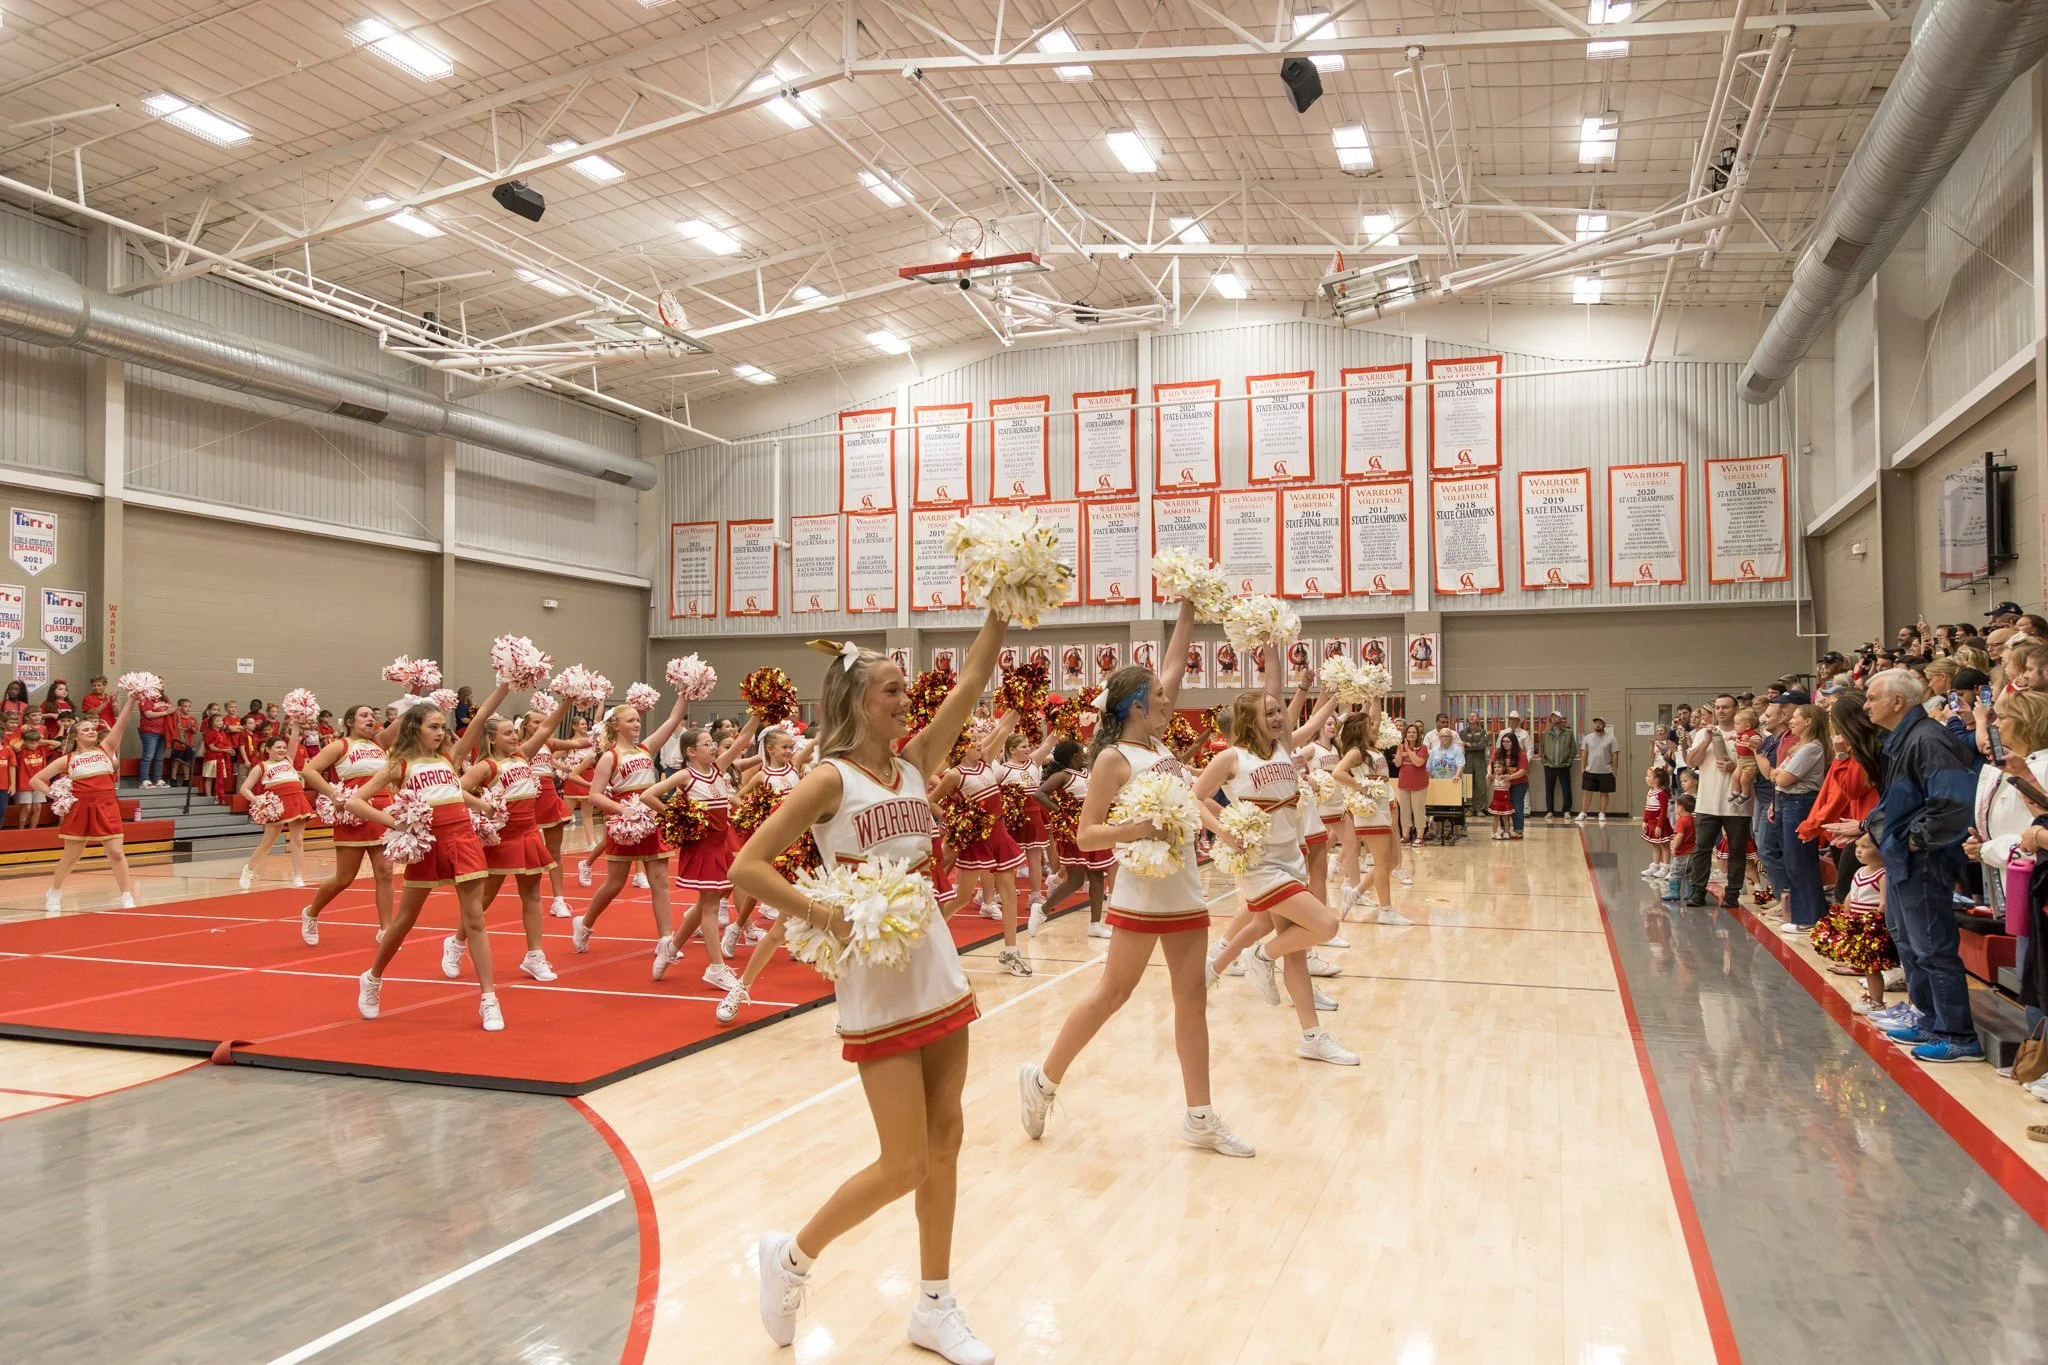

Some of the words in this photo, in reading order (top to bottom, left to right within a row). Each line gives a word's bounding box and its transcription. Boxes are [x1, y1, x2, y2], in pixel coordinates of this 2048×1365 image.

[1357, 373, 1395, 381] WARRIOR
[1274, 379, 1306, 388] WARRIOR
[1437, 390, 1455, 398] STATE
[1456, 388, 1494, 396] CHAMPIONS
[1088, 397, 1122, 405] WARRIOR
[1350, 396, 1367, 404] STATE
[1367, 394, 1403, 403] CHAMPIONS
[1256, 404, 1272, 412] STATE
[1273, 403, 1289, 411] FINAL
[1163, 413, 1179, 421] STATE
[1179, 411, 1212, 419] CHAMPIONS
[1720, 464, 1771, 472] WARRIOR
[1623, 471, 1670, 480] WARRIOR
[1529, 478, 1579, 487] WARRIOR
[1736, 482, 1756, 490] 2021
[1441, 483, 1489, 493] WARRIOR
[1737, 488, 1776, 496] CHAMPIONS
[1290, 493, 1335, 501] WARRIOR
[1356, 489, 1403, 497] WARRIOR
[1443, 493, 1488, 501] VOLLEYBALL
[1543, 497, 1564, 505] 2019
[1637, 495, 1674, 503] CHAMPIONS
[1455, 502, 1476, 510] 2018
[1526, 506, 1549, 515] STATE
[1550, 505, 1584, 514] FINALIST
[1436, 510, 1455, 520] STATE
[1455, 507, 1494, 518] CHAMPIONS
[1286, 519, 1303, 528] STATE
[1304, 518, 1321, 527] FINAL
[1323, 518, 1339, 526] FOUR
[1351, 516, 1370, 525] STATE
[1370, 513, 1408, 524] CHAMPIONS
[1158, 524, 1174, 532] STATE
[1175, 523, 1207, 531] CHAMPIONS
[14, 544, 52, 555] CHAMPION
[23, 556, 43, 564] 2021
[53, 617, 75, 625] GOLF
[45, 624, 83, 635] CHAMPION
[54, 635, 73, 643] 2025
[108, 604, 118, 665] WARRIORS
[70, 754, 108, 770] WARRIORS
[406, 770, 460, 790] WARRIORS
